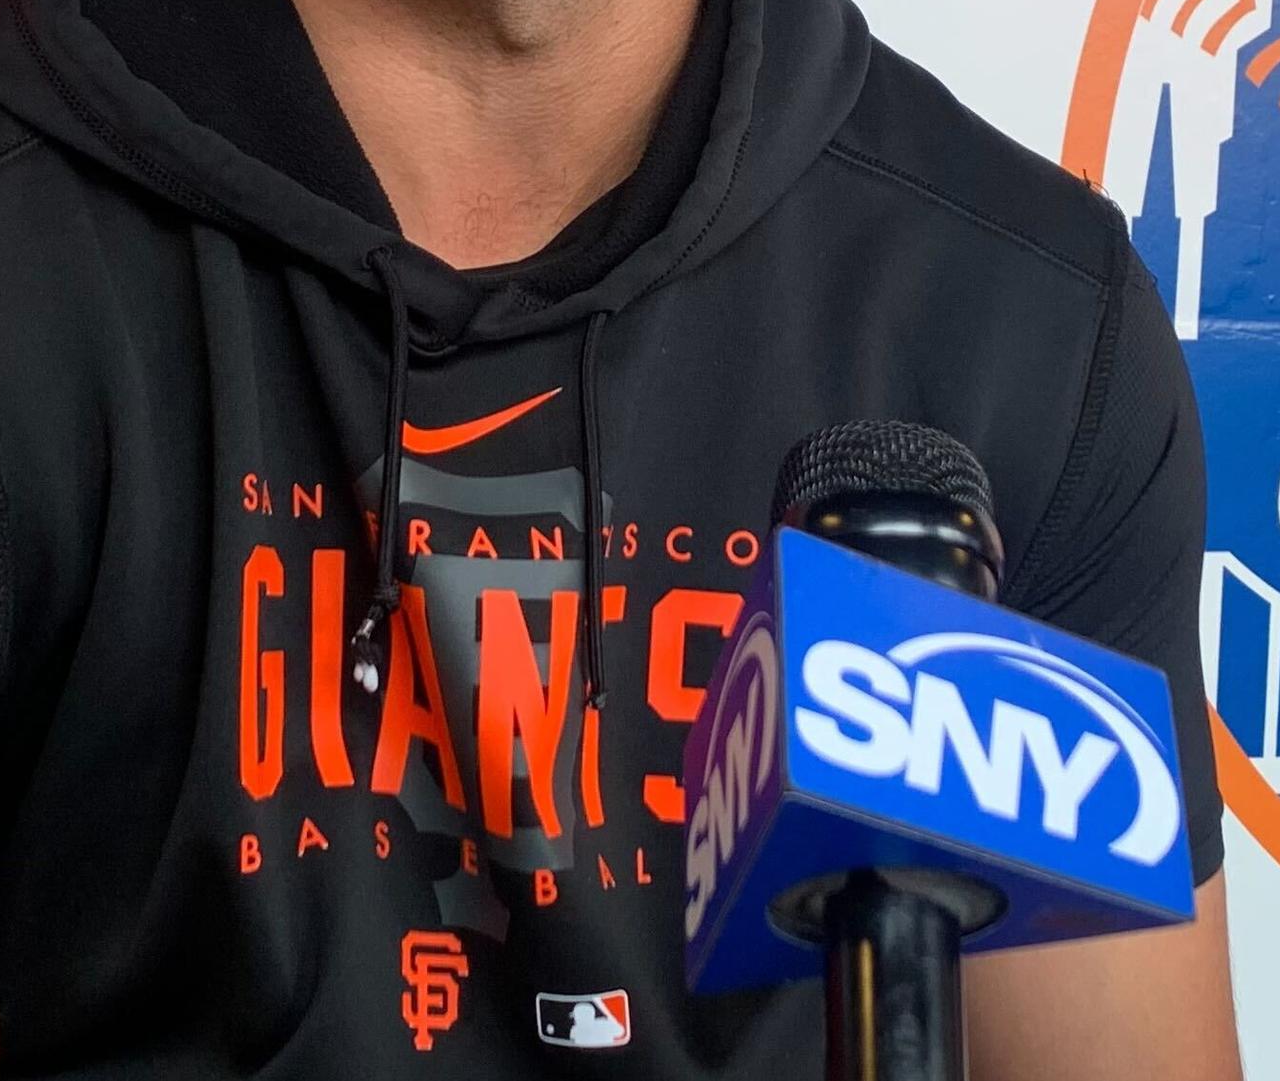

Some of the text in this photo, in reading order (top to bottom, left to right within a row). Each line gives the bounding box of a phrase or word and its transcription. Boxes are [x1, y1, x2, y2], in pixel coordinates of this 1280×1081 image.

[242, 473, 759, 567] SAN FRANISCO
[794, 638, 1120, 840] SNY
[240, 817, 652, 907] BASEBAL
